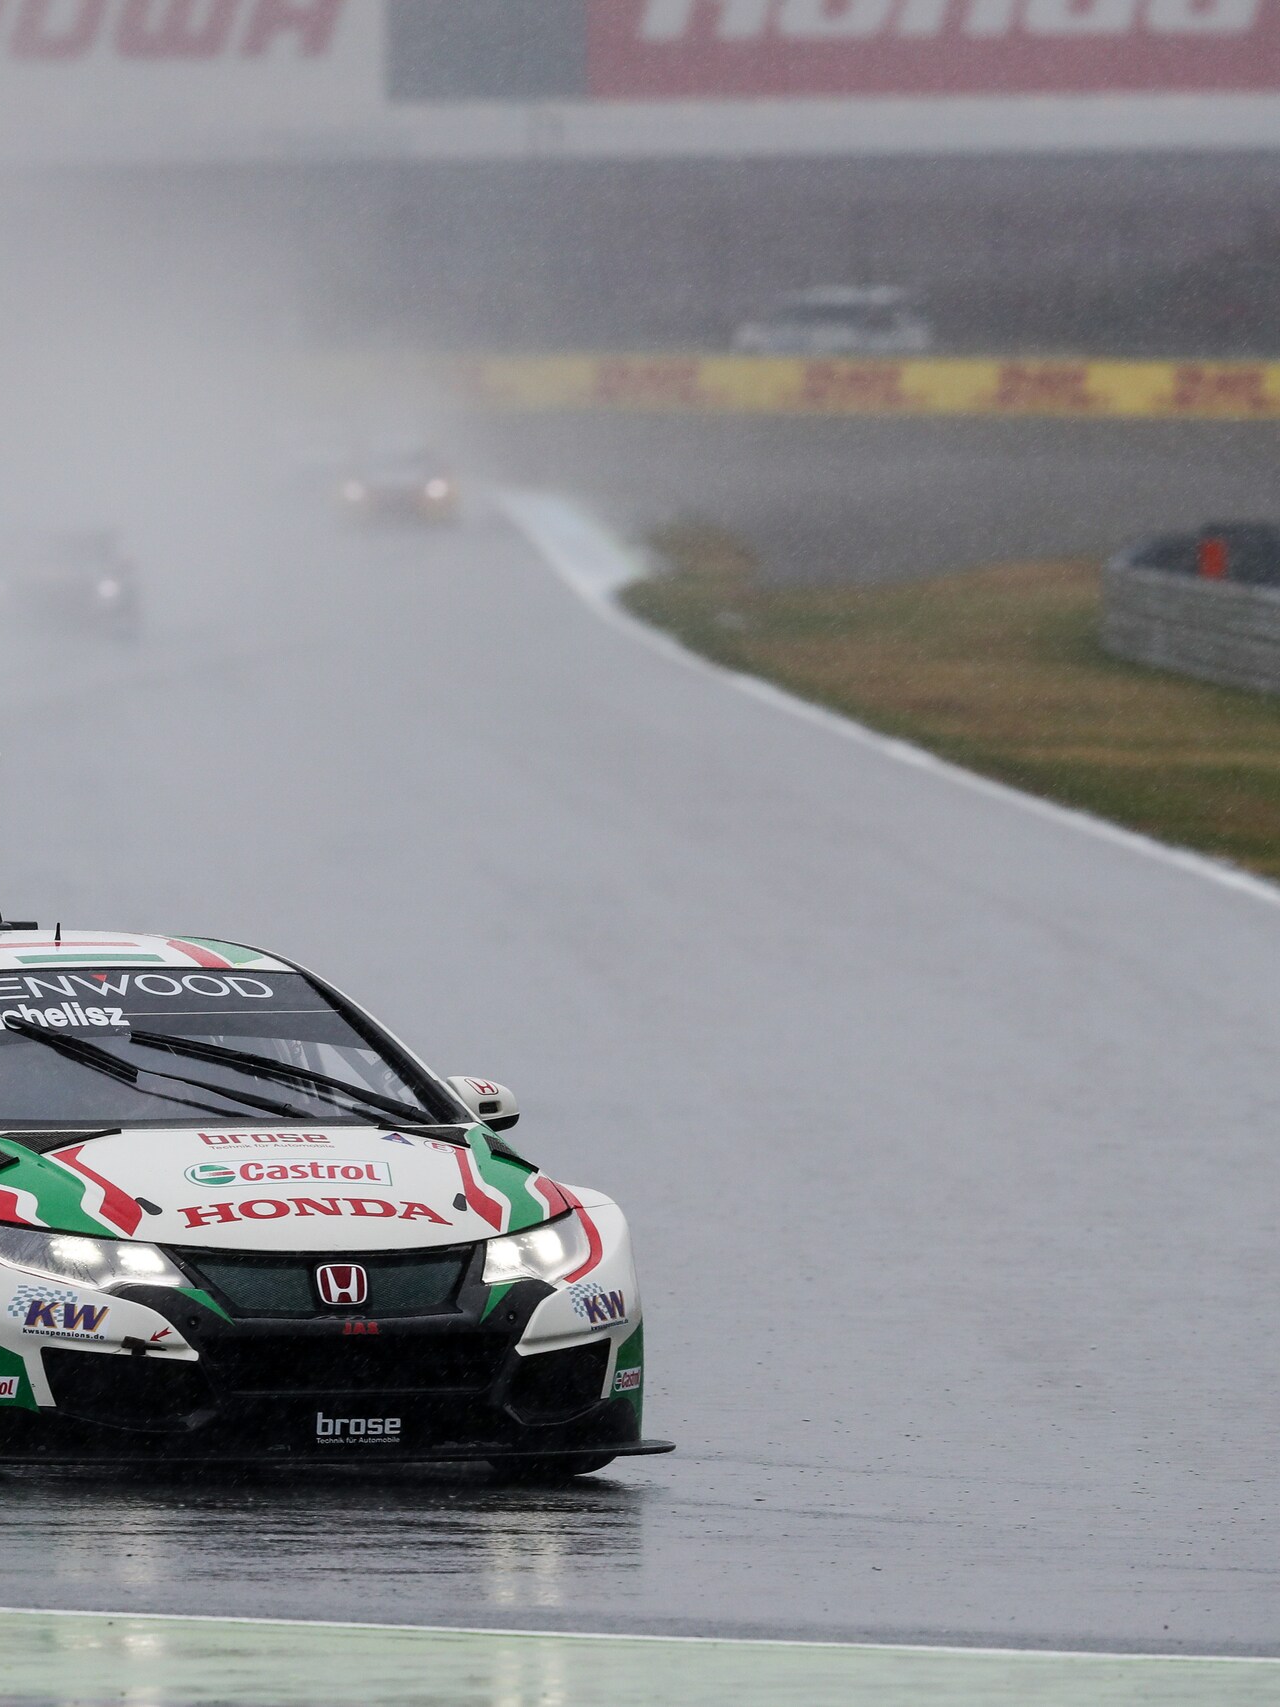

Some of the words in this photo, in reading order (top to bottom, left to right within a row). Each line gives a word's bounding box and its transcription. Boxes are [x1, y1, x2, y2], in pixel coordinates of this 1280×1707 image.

[197, 1132, 331, 1145] brose
[239, 1162, 381, 1181] Castrol
[177, 1197, 454, 1229] HONDA
[24, 1300, 110, 1332] KW
[583, 1290, 625, 1324] KW
[22, 1328, 105, 1340] kwsuspensions.de
[316, 1412, 401, 1435] brose
